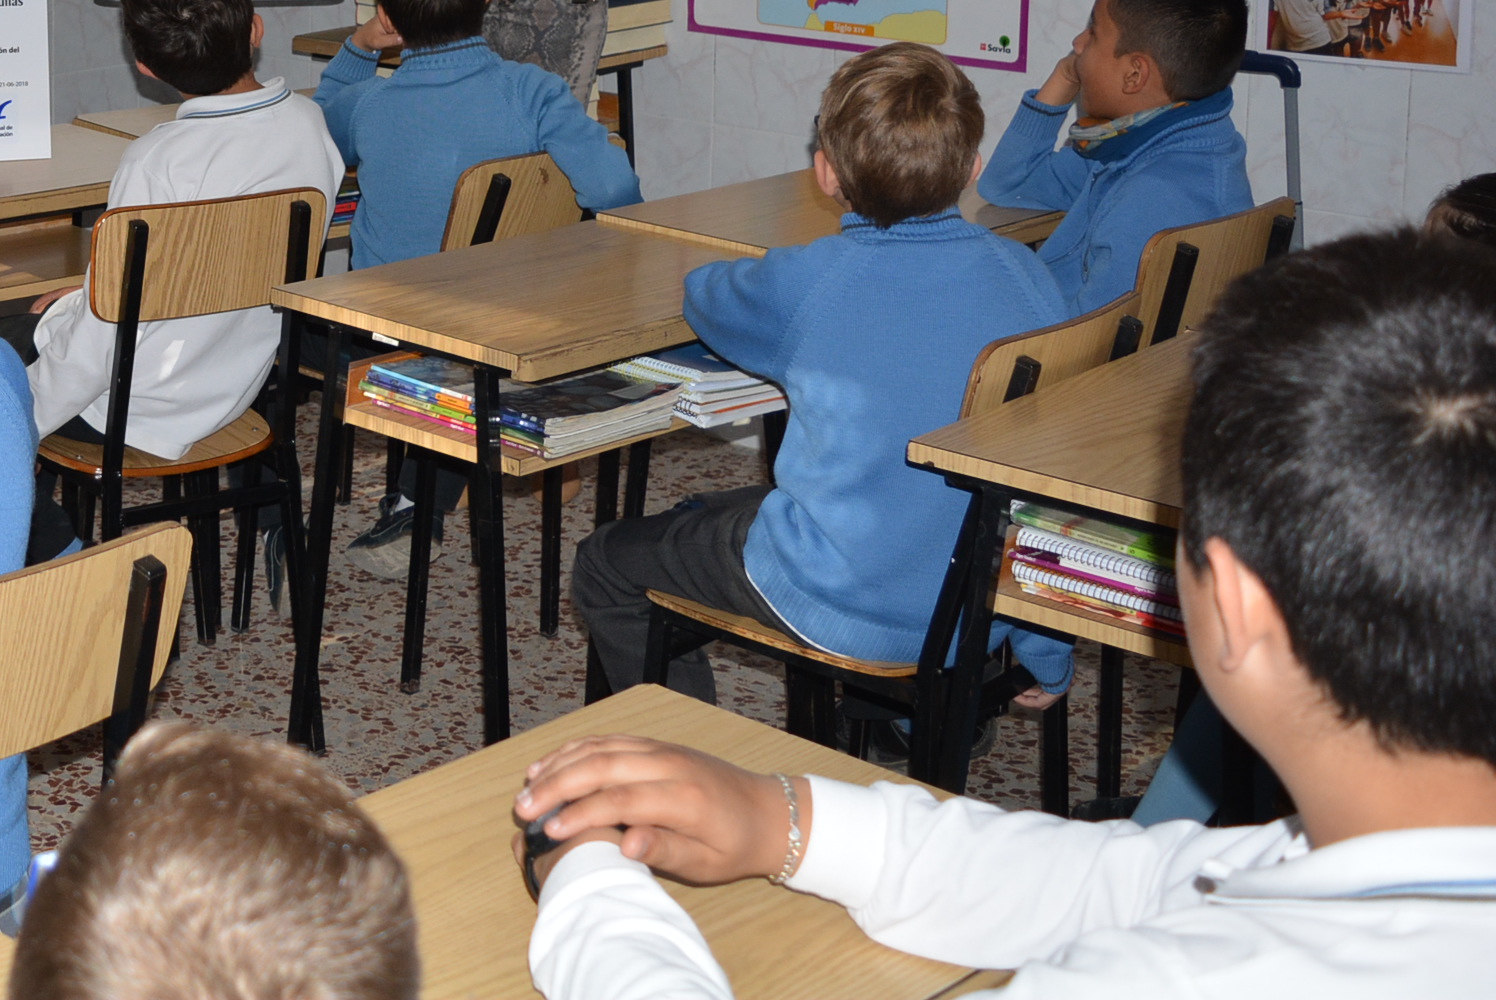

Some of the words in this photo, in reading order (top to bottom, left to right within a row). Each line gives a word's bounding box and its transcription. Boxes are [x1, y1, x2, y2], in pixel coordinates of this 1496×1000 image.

[832, 22, 851, 34] Siglo
[9, 46, 20, 54] del
[987, 43, 1012, 54] Savia
